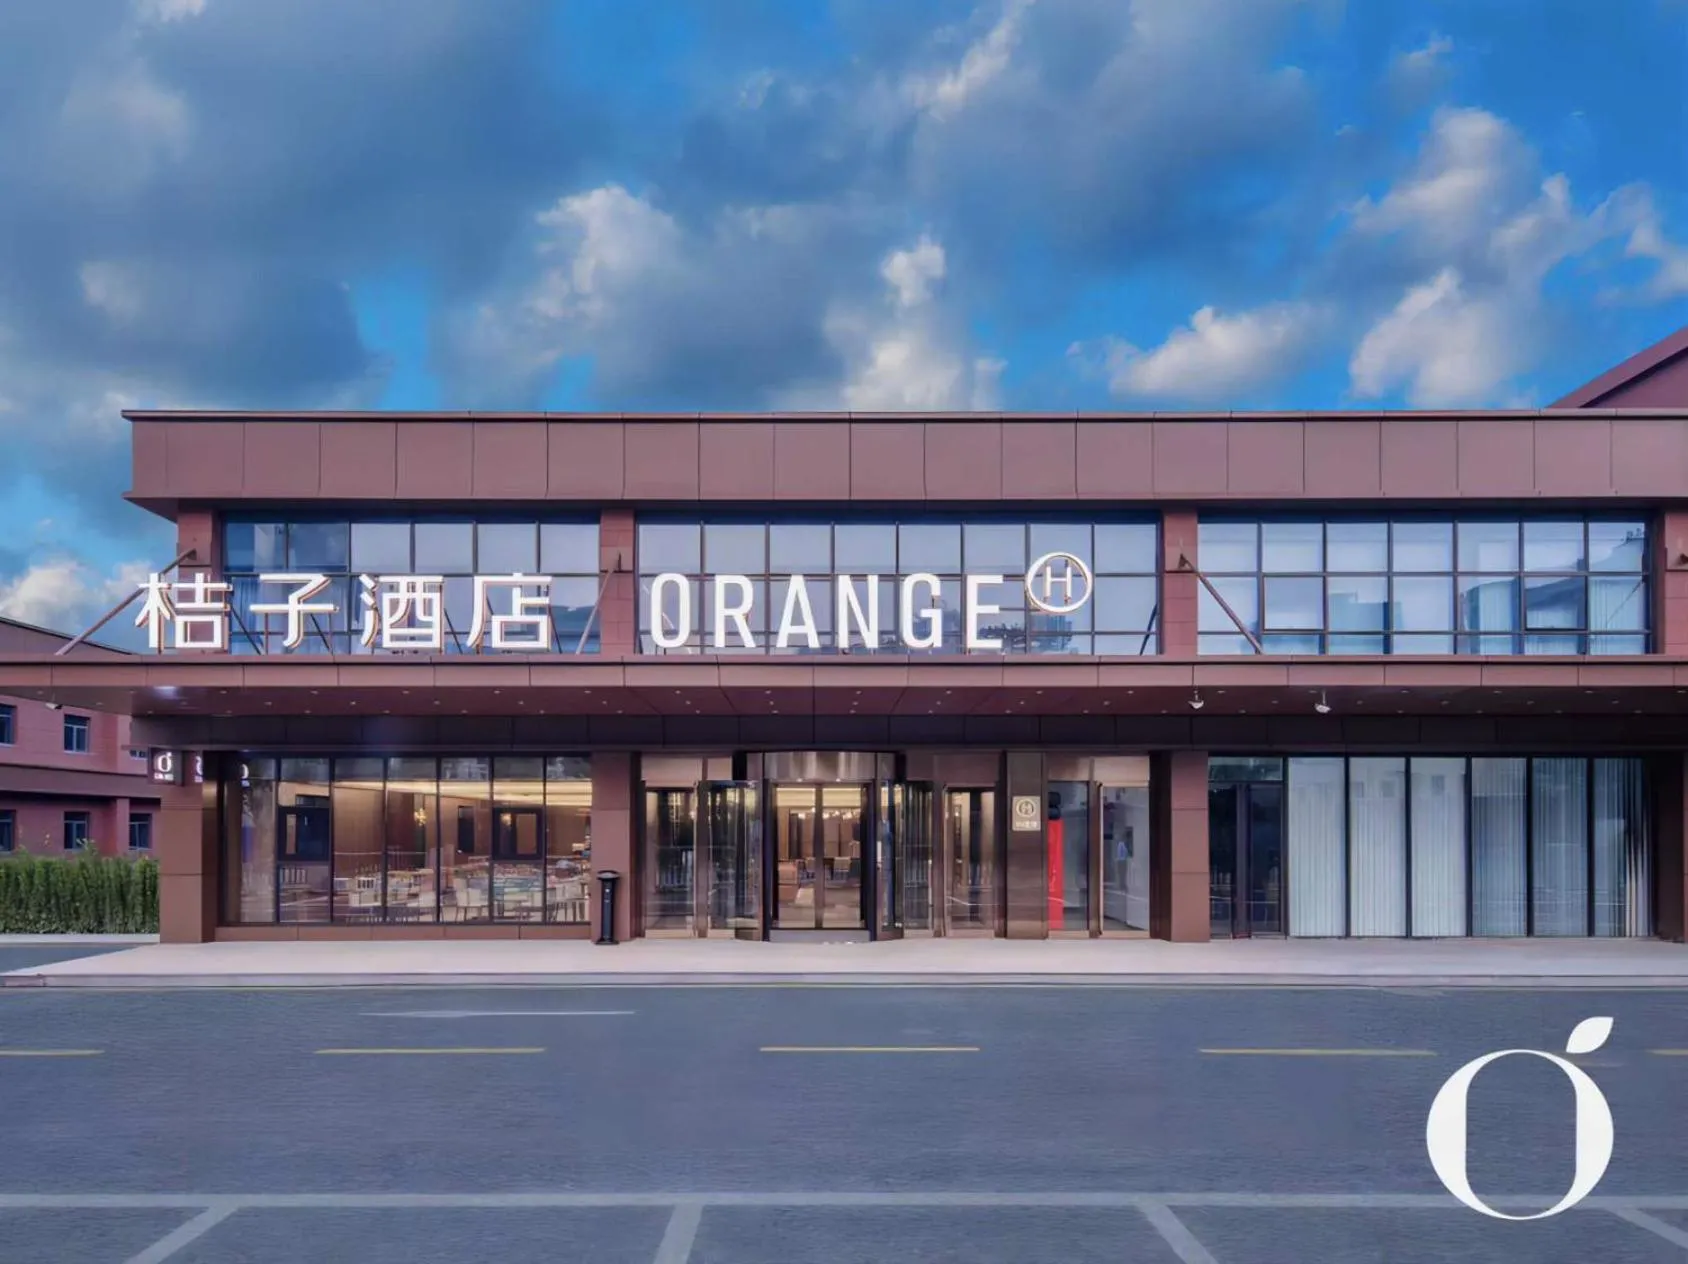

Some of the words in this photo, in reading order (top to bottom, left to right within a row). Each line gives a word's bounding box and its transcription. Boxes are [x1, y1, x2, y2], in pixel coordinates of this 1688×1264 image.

[135, 572, 553, 650] 桔子酒店
[649, 572, 1004, 649] ORANGE
